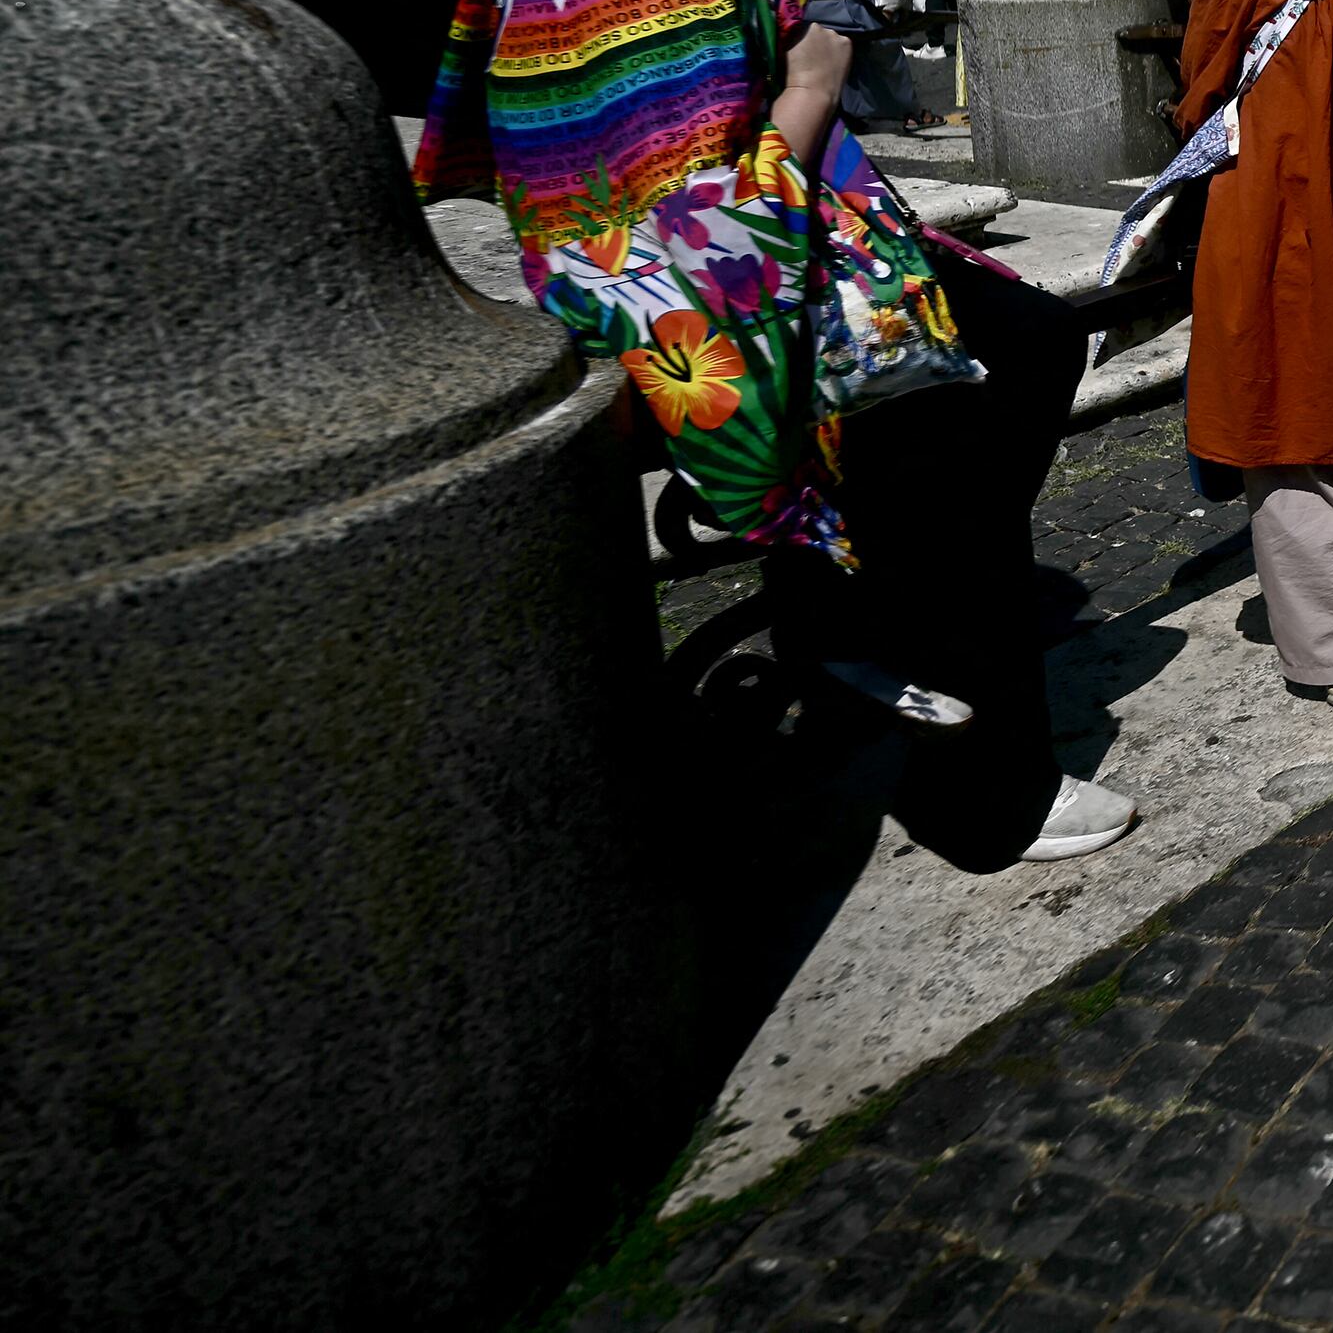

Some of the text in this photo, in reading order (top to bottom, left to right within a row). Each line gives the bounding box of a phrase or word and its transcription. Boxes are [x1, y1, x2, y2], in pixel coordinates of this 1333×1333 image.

[646, 0, 674, 14] DO
[626, 22, 653, 36] DO
[544, 52, 572, 65] DO
[628, 53, 655, 69] DO
[605, 82, 626, 99] DO
